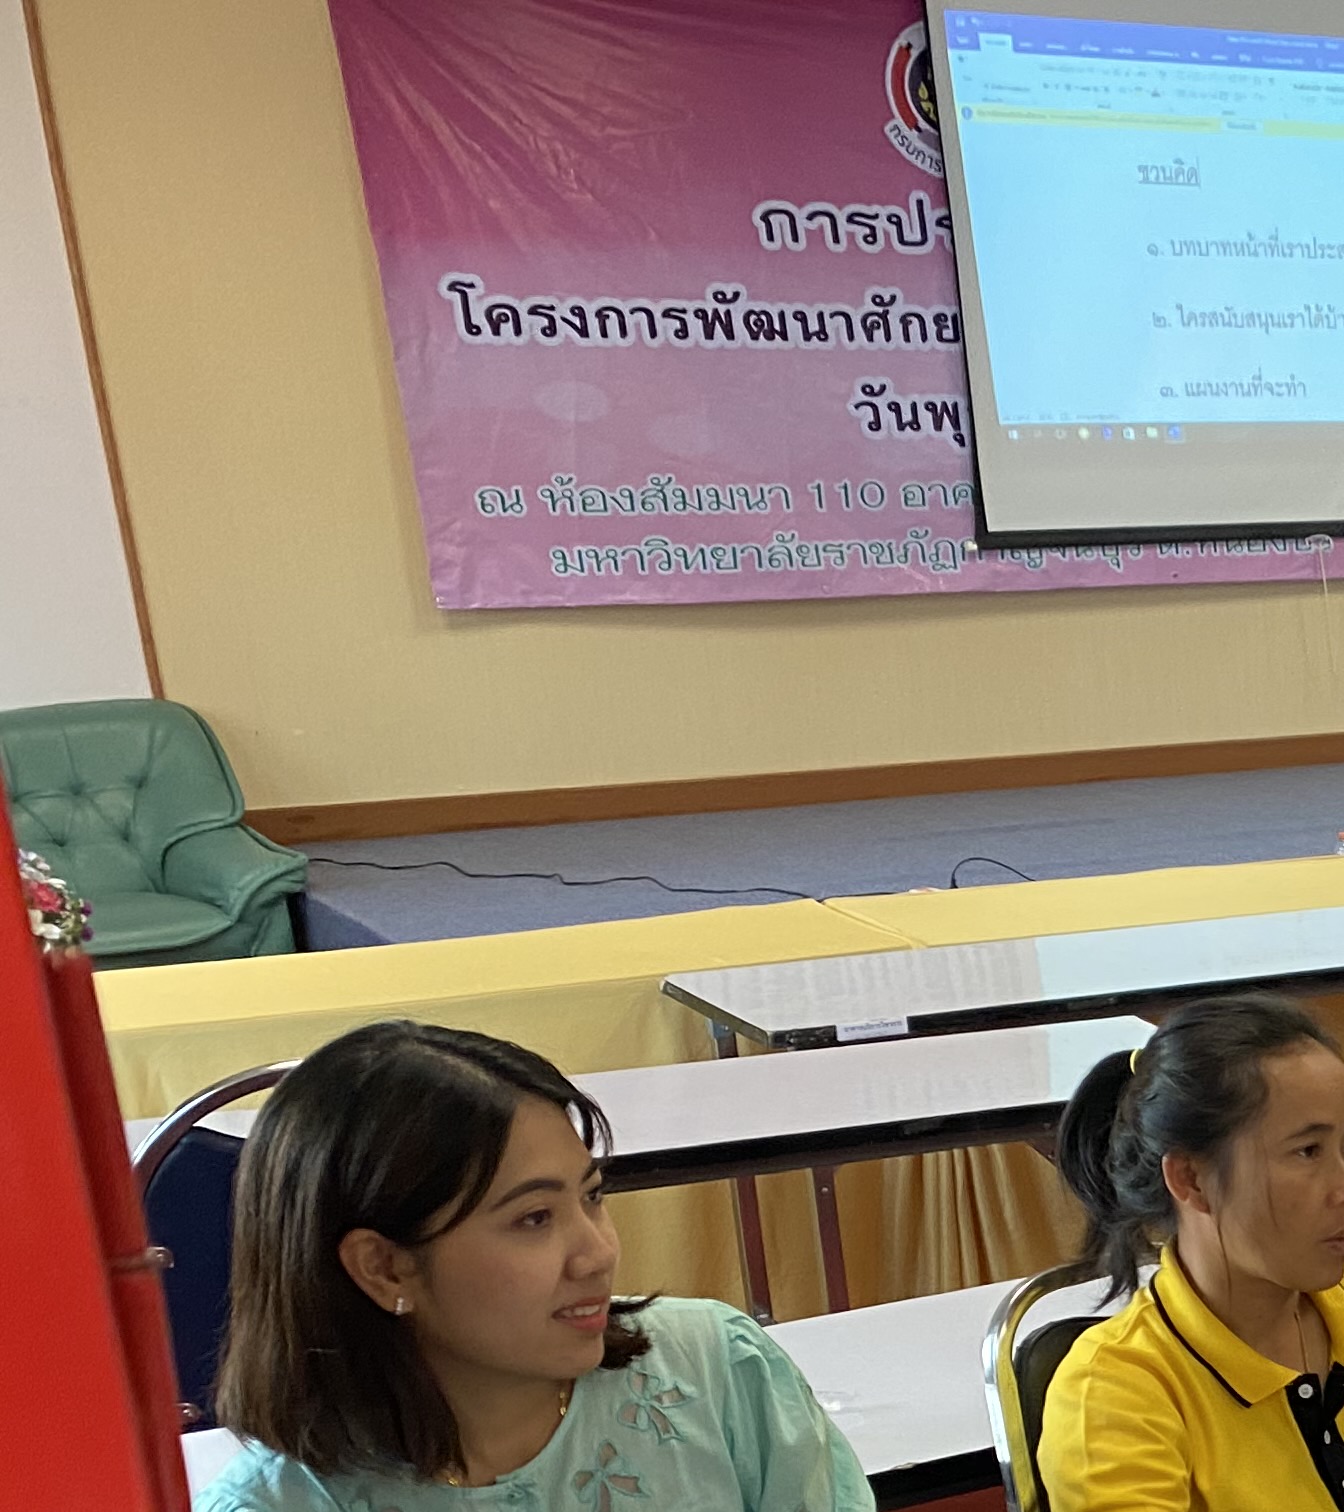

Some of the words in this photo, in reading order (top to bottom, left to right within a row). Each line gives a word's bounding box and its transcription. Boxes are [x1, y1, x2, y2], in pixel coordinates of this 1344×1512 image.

[478, 486, 523, 514] ณ
[539, 475, 792, 514] ห้องสัมมนา
[810, 480, 886, 509] 110
